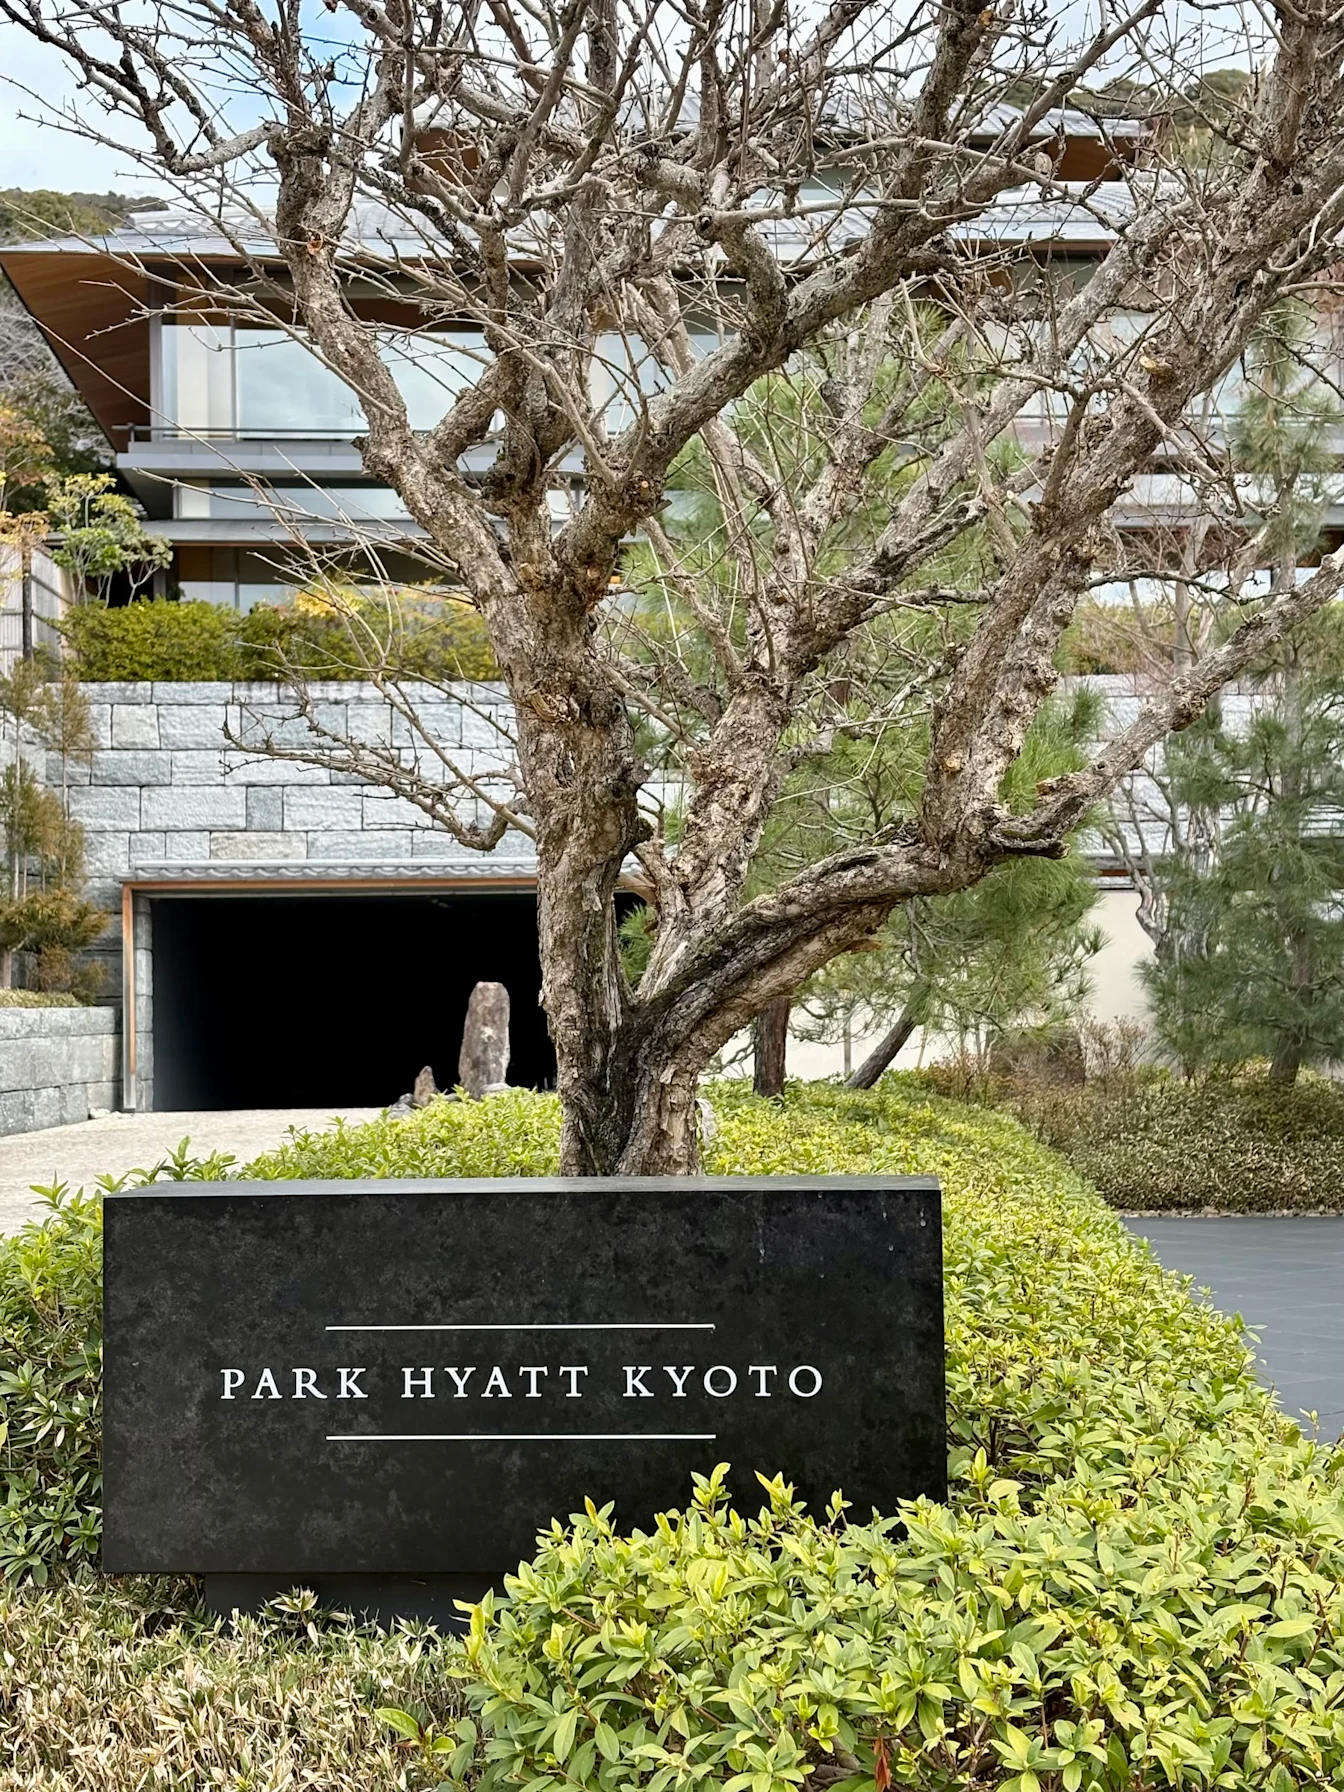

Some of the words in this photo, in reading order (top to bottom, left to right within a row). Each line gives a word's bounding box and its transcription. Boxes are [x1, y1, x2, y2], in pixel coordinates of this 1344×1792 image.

[219, 1367, 369, 1400] PARK
[400, 1365, 590, 1398] HYATT
[622, 1364, 823, 1398] KYOTO
